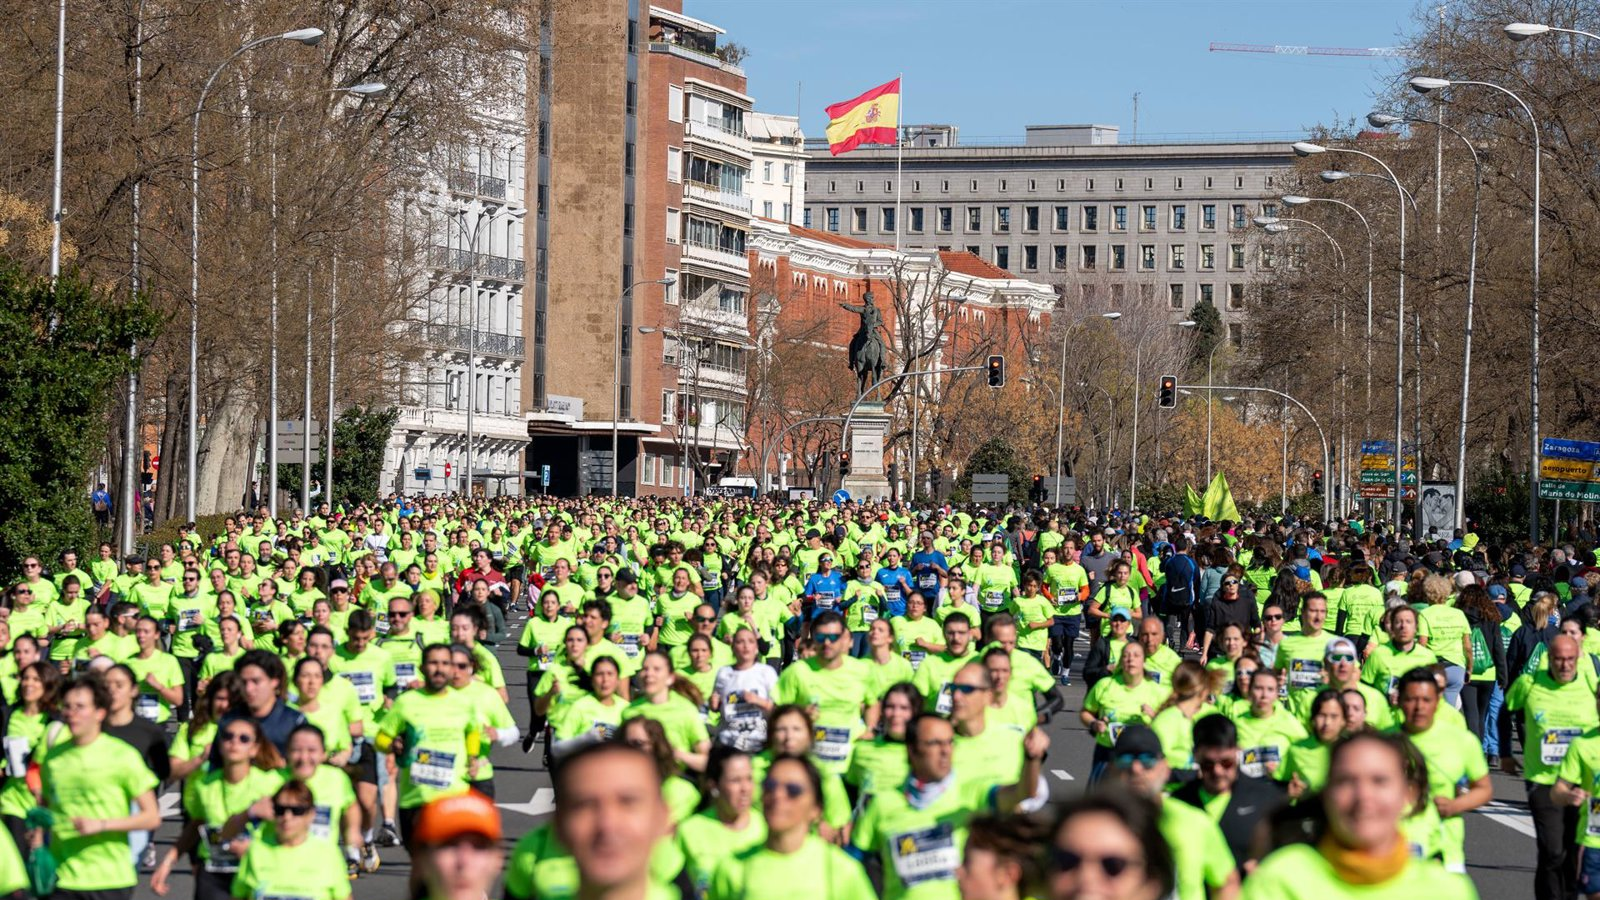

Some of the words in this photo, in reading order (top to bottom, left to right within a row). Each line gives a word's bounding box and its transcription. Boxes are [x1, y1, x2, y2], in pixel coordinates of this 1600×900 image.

[1544, 443, 1580, 453] Zaragoza
[1543, 466, 1587, 474] aeropuerto
[1577, 491, 1600, 499] Molin
